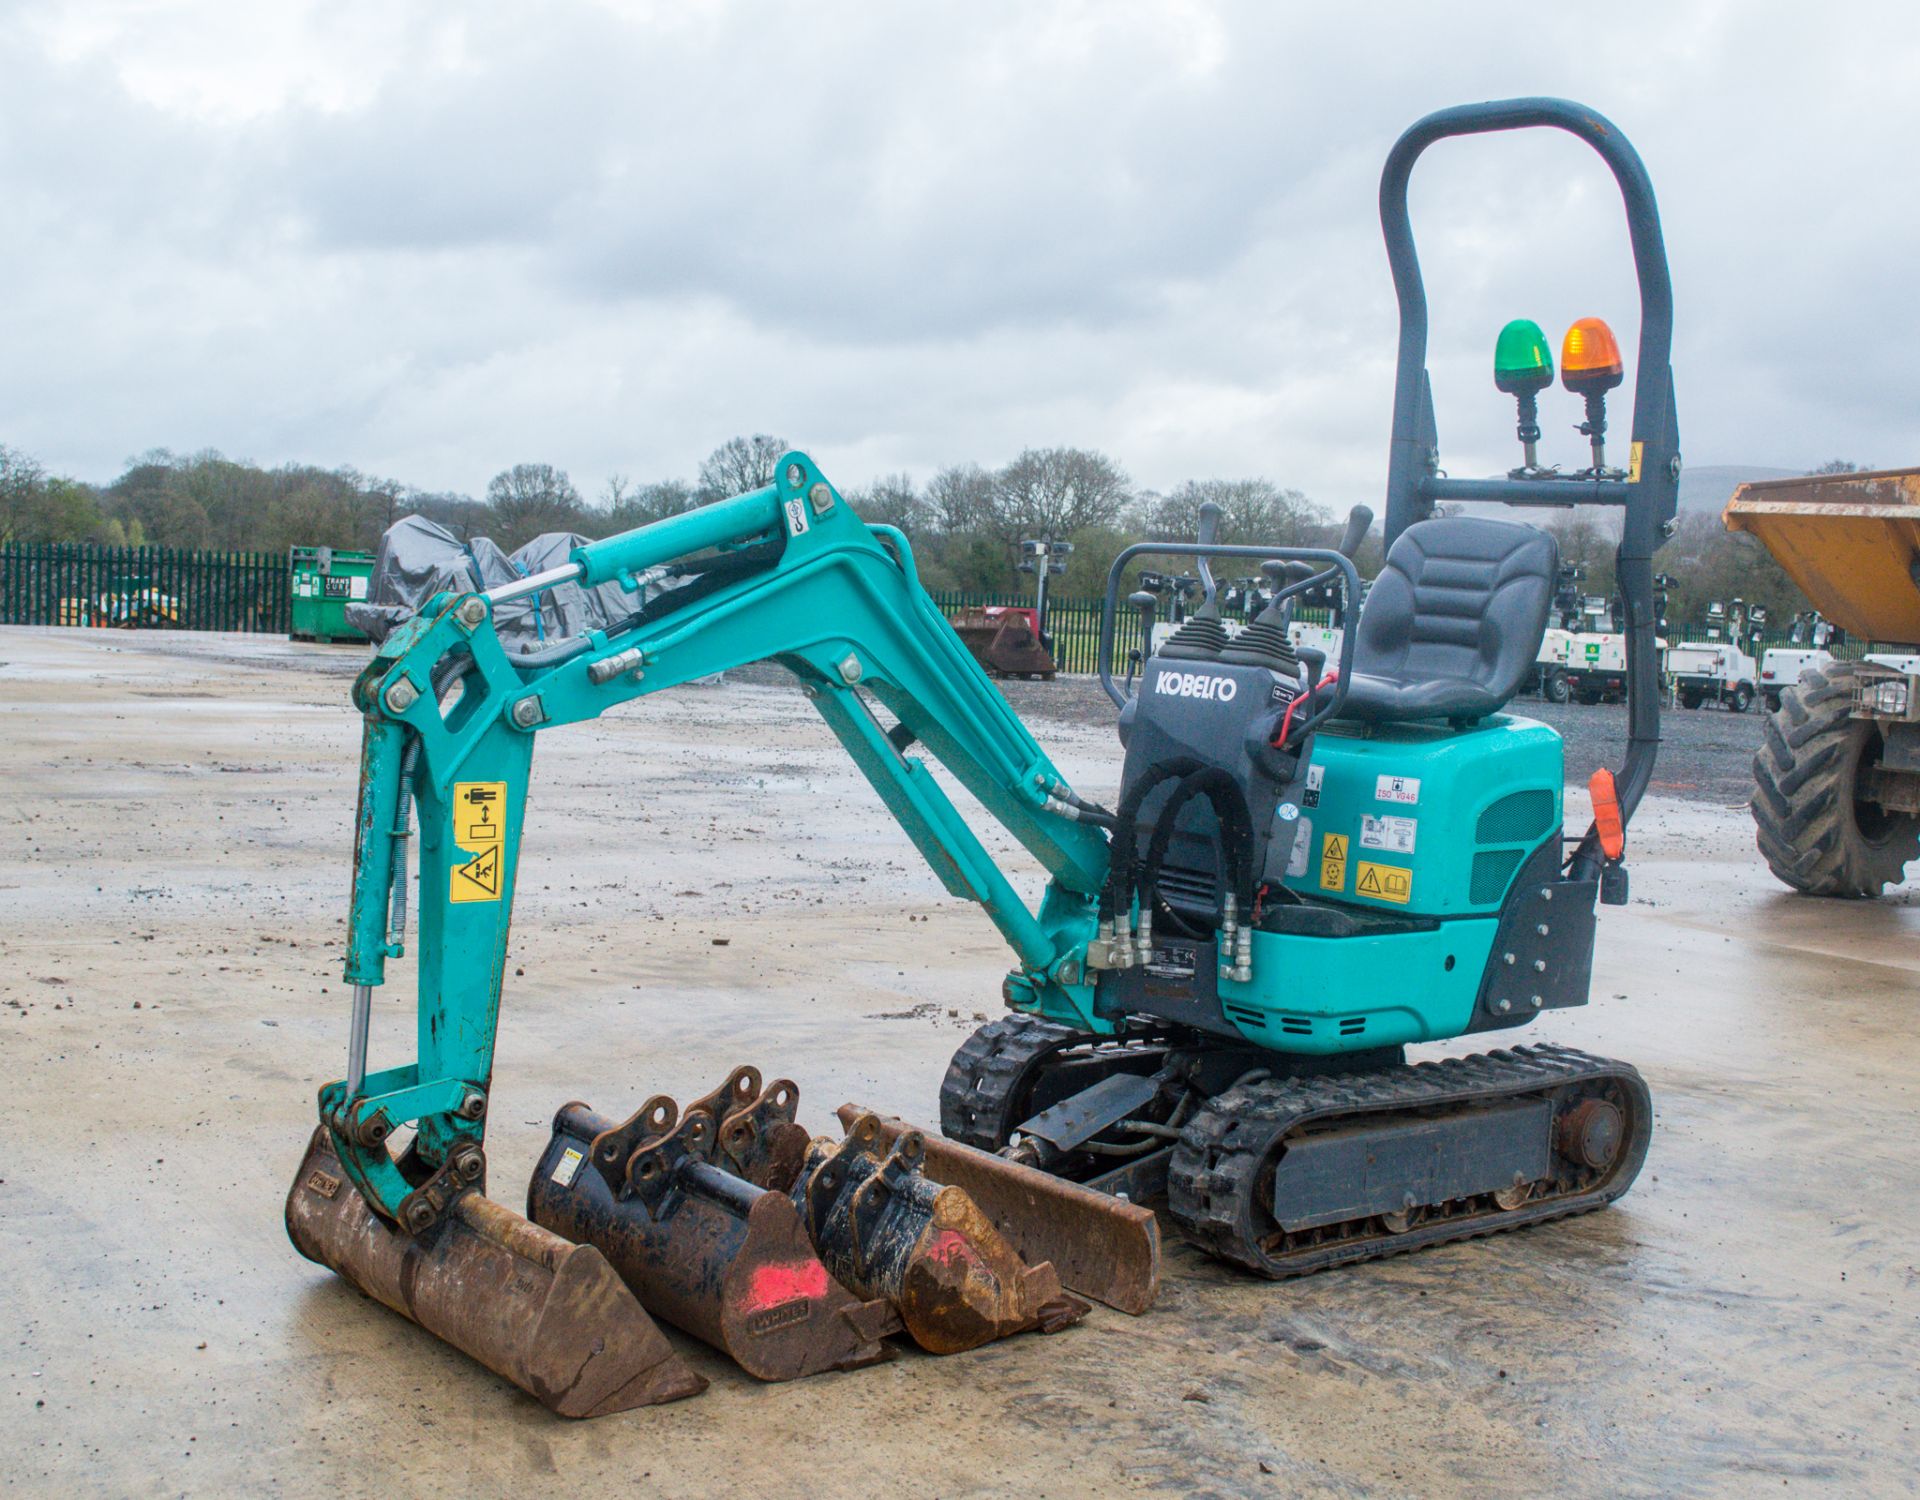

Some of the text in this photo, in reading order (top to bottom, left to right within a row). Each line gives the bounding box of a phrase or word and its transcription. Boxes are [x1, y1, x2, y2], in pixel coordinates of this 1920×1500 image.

[1155, 671, 1237, 702] KOBELCO
[1377, 789, 1416, 802] ISO VG46
